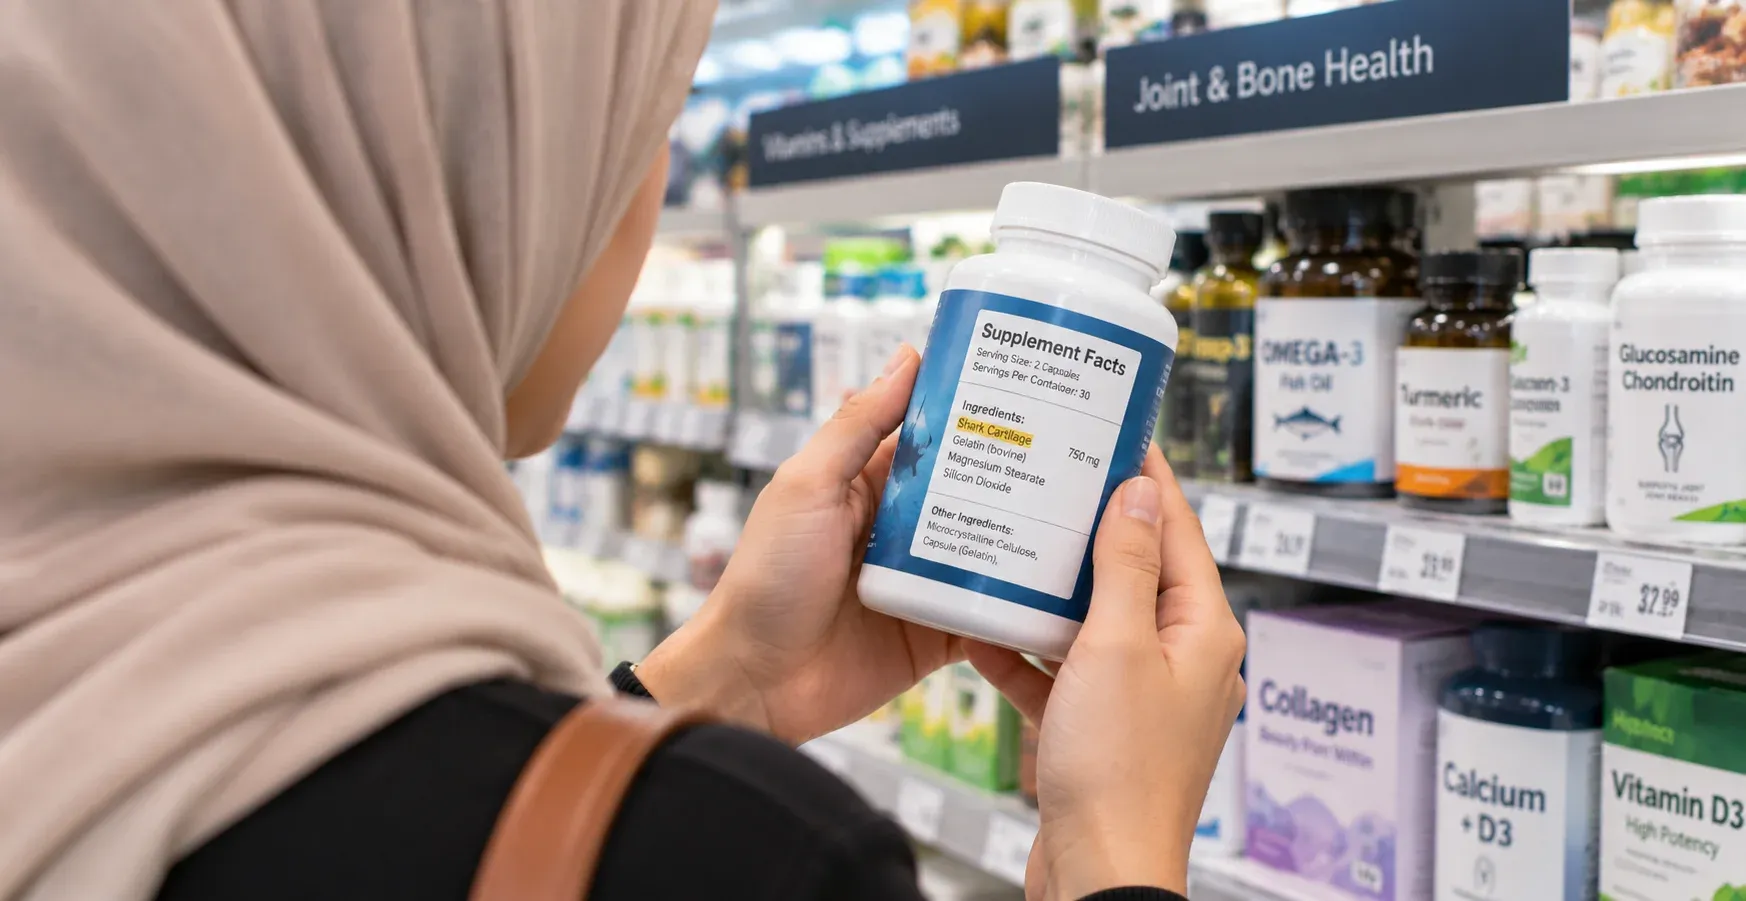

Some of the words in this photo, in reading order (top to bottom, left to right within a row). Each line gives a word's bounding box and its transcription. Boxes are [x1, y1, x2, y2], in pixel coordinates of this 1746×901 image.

[1133, 72, 1200, 113] Joint
[1206, 66, 1230, 101] &
[1237, 60, 1314, 98] Bone
[1324, 34, 1434, 86] Health
[846, 106, 960, 153] Supplements
[976, 347, 1009, 363] Serving
[1010, 354, 1033, 368] Size:
[1033, 360, 1041, 370] 2
[981, 322, 1081, 361] Supplement
[1084, 348, 1126, 376] Facts
[1262, 340, 1366, 366] OMEGA-3
[1618, 343, 1741, 365] Glucosamine
[972, 361, 1010, 378] Servings
[1011, 370, 1028, 382] Per
[1078, 388, 1091, 400] 30
[1622, 370, 1735, 393] Chondroitin
[962, 399, 1025, 424] Ingredients:
[957, 417, 985, 434] Shark
[987, 424, 1032, 446] Cartilage
[952, 434, 985, 451] Gelatin
[986, 442, 1027, 464] (bovine)
[1068, 447, 1086, 462] 750
[1086, 456, 1100, 469] mg
[943, 467, 974, 484] Silicon
[975, 475, 1012, 495] Dioxide
[947, 451, 1002, 474] Magnesium
[1004, 465, 1046, 487] Stearate
[931, 505, 957, 520] Other
[957, 512, 1014, 536] Ingredients:
[923, 536, 957, 553] Capsule
[996, 539, 1038, 561] Cellulose,
[1260, 678, 1374, 737] Collagen
[1444, 761, 1546, 813] Calcium
[1611, 769, 1705, 820] Vitamin
[1711, 794, 1745, 830] D3
[1460, 814, 1473, 834] +
[1478, 813, 1513, 848] D3
[1625, 815, 1658, 844] High
[1660, 825, 1720, 861] Potency
